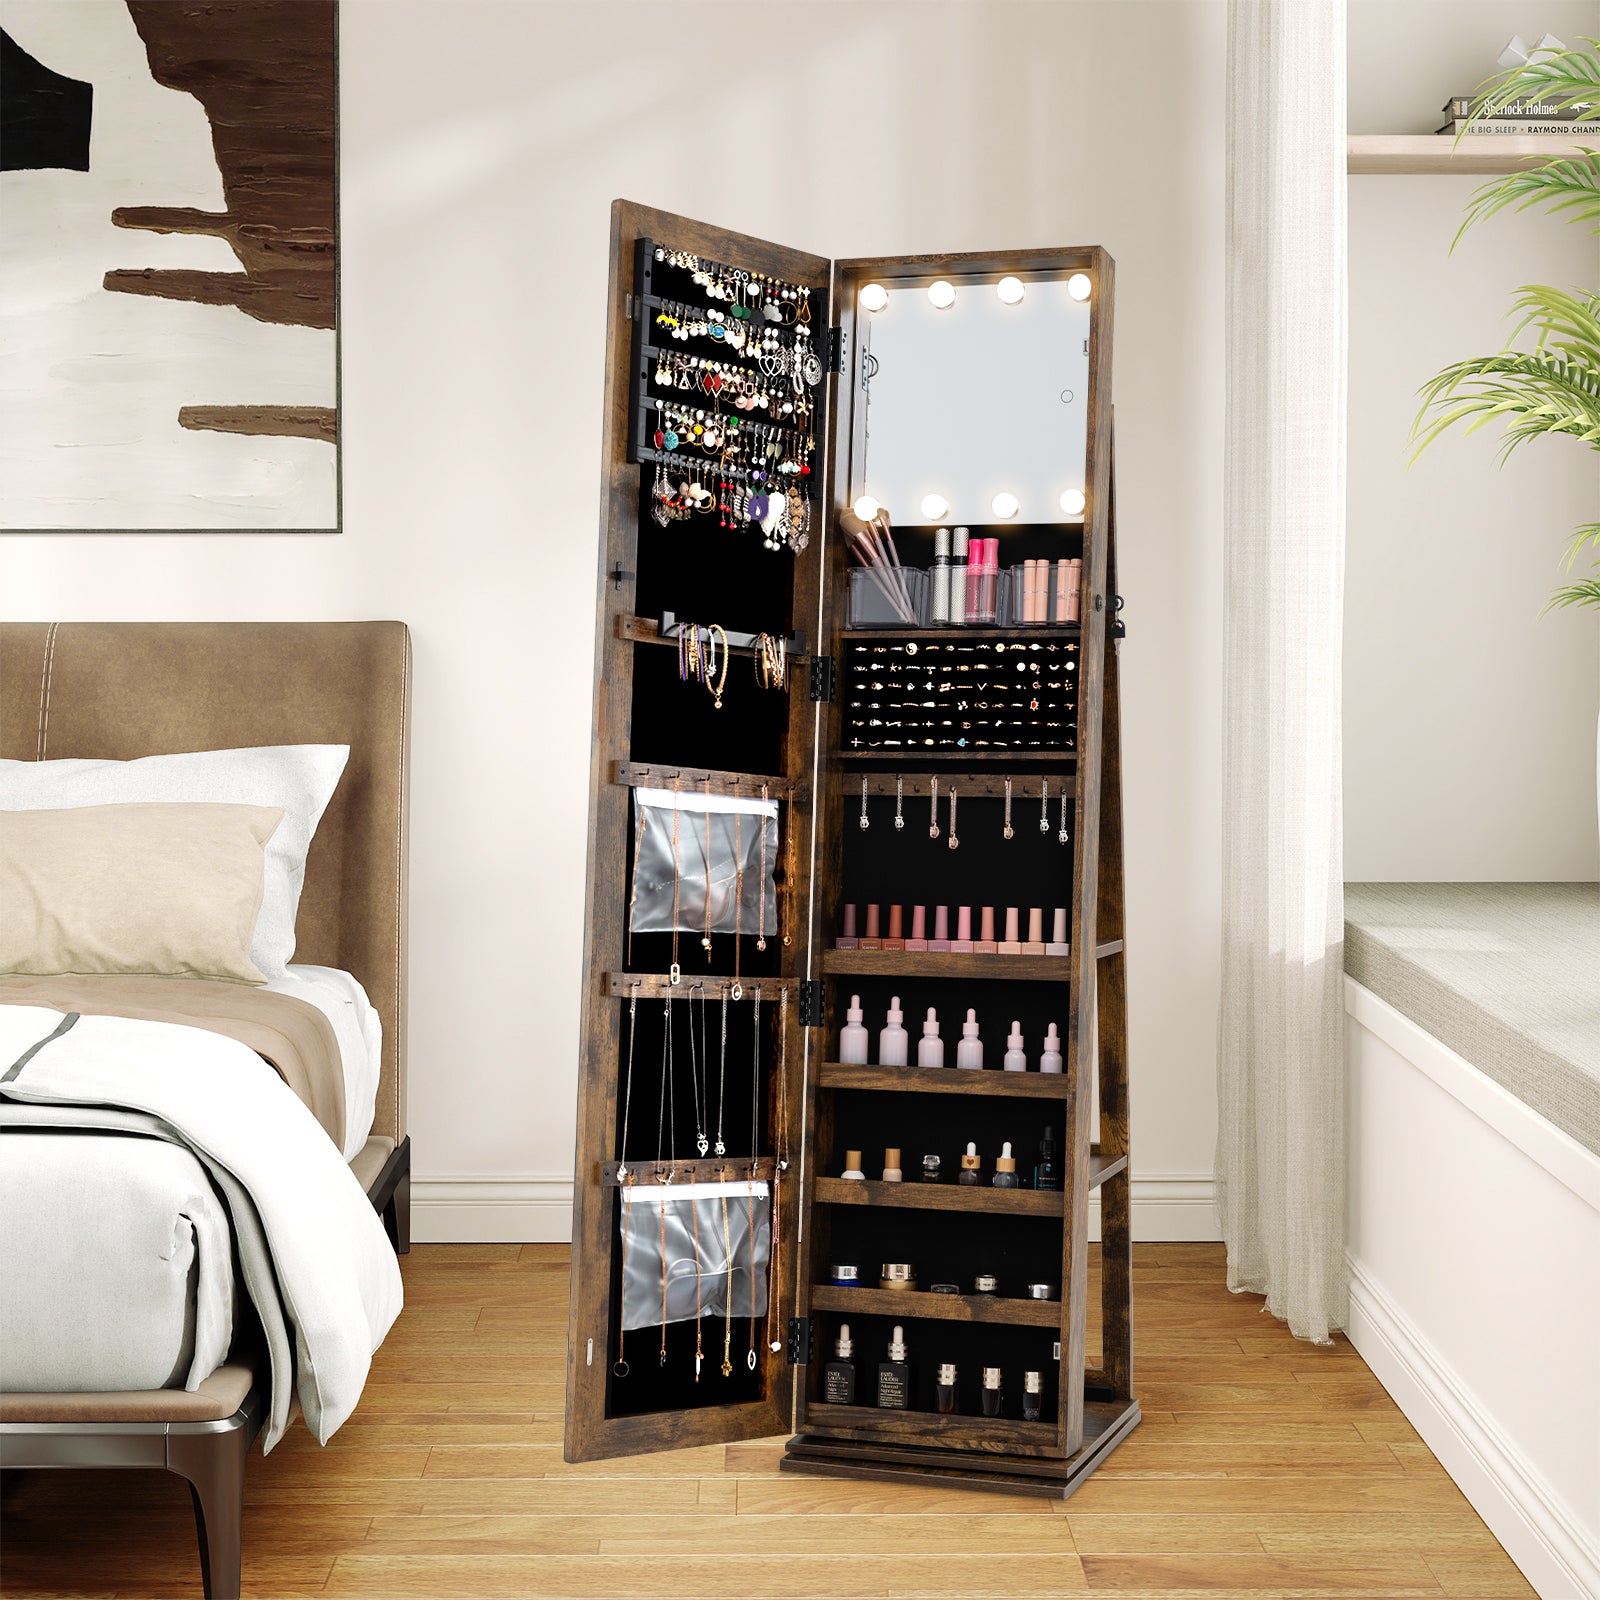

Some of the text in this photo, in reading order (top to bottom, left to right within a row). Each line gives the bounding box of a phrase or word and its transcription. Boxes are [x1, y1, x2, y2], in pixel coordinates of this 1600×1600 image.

[1525, 99, 1558, 115] Holmes
[1460, 126, 1475, 134] HE
[1478, 126, 1492, 134] BIG
[1494, 126, 1517, 134] SLEEP
[1527, 126, 1569, 134] RAYMOND
